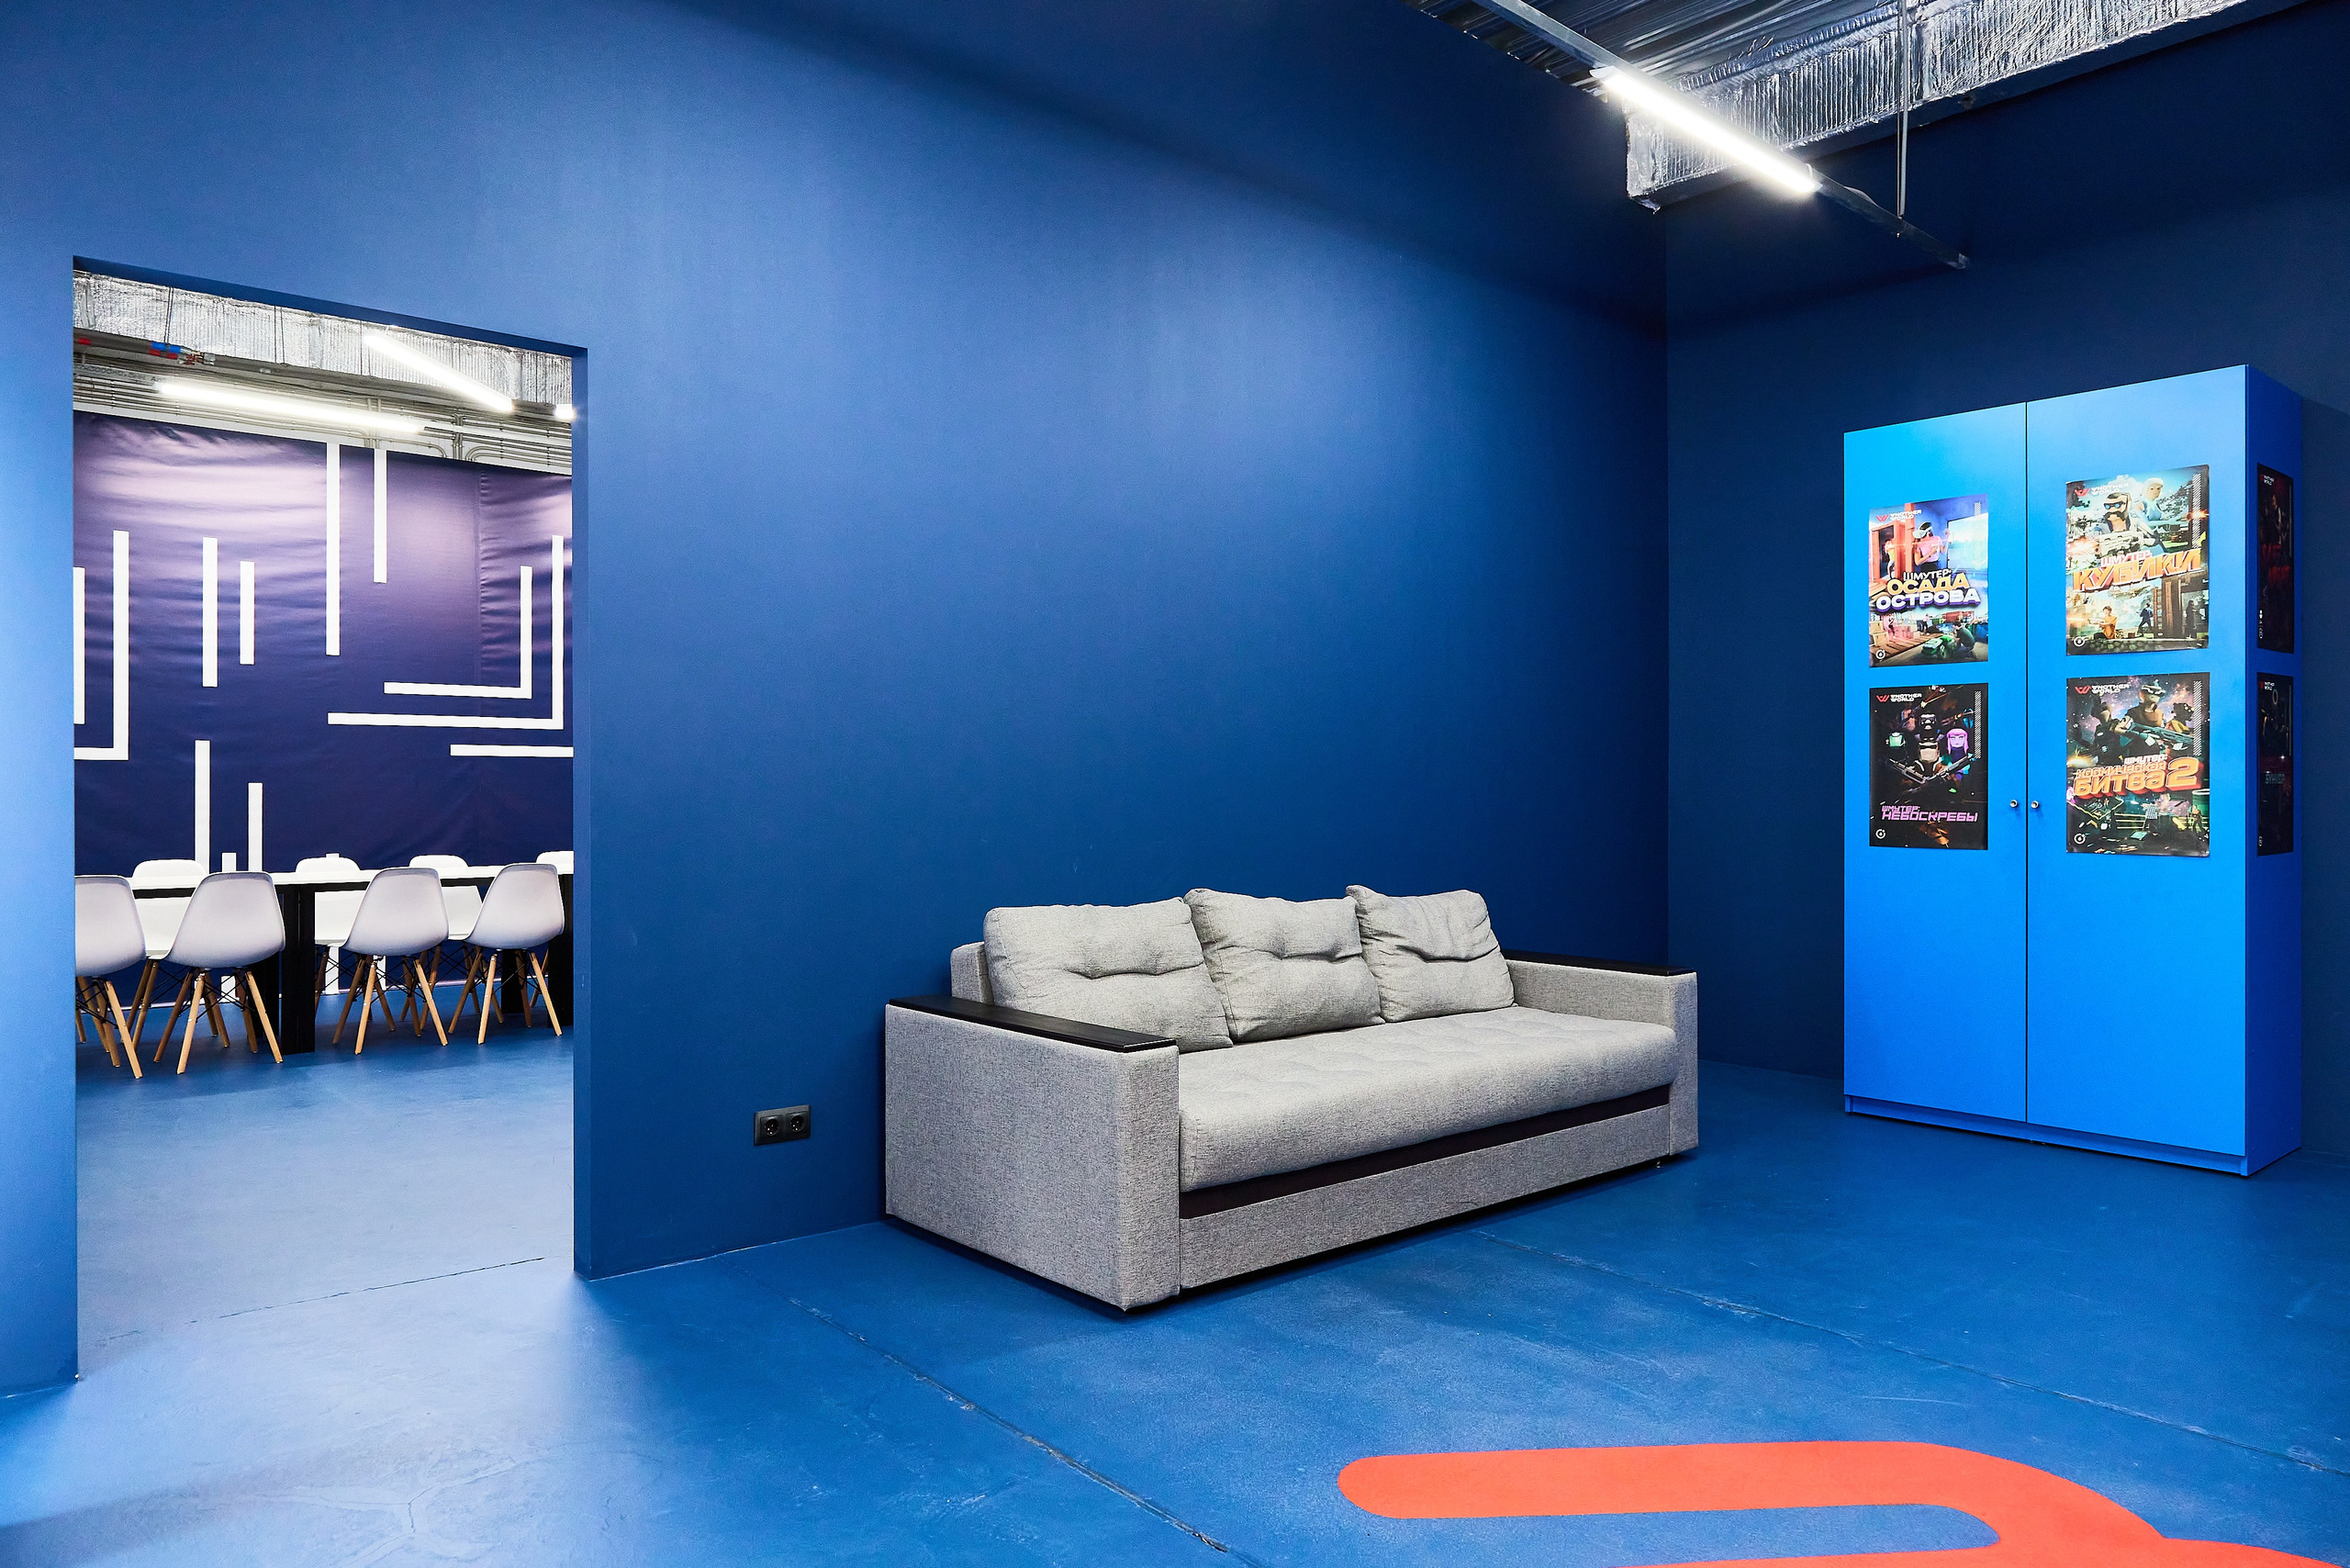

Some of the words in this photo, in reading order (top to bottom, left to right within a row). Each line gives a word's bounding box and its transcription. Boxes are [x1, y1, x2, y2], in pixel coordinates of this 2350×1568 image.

[2073, 549, 2202, 591] КУБИКИ
[1886, 572, 1971, 596] ОСАДА
[1875, 588, 1981, 612] ОСТРОВА
[2165, 756, 2203, 790] 2
[1881, 812, 1978, 823] НЕБОСКРЕБЫ
